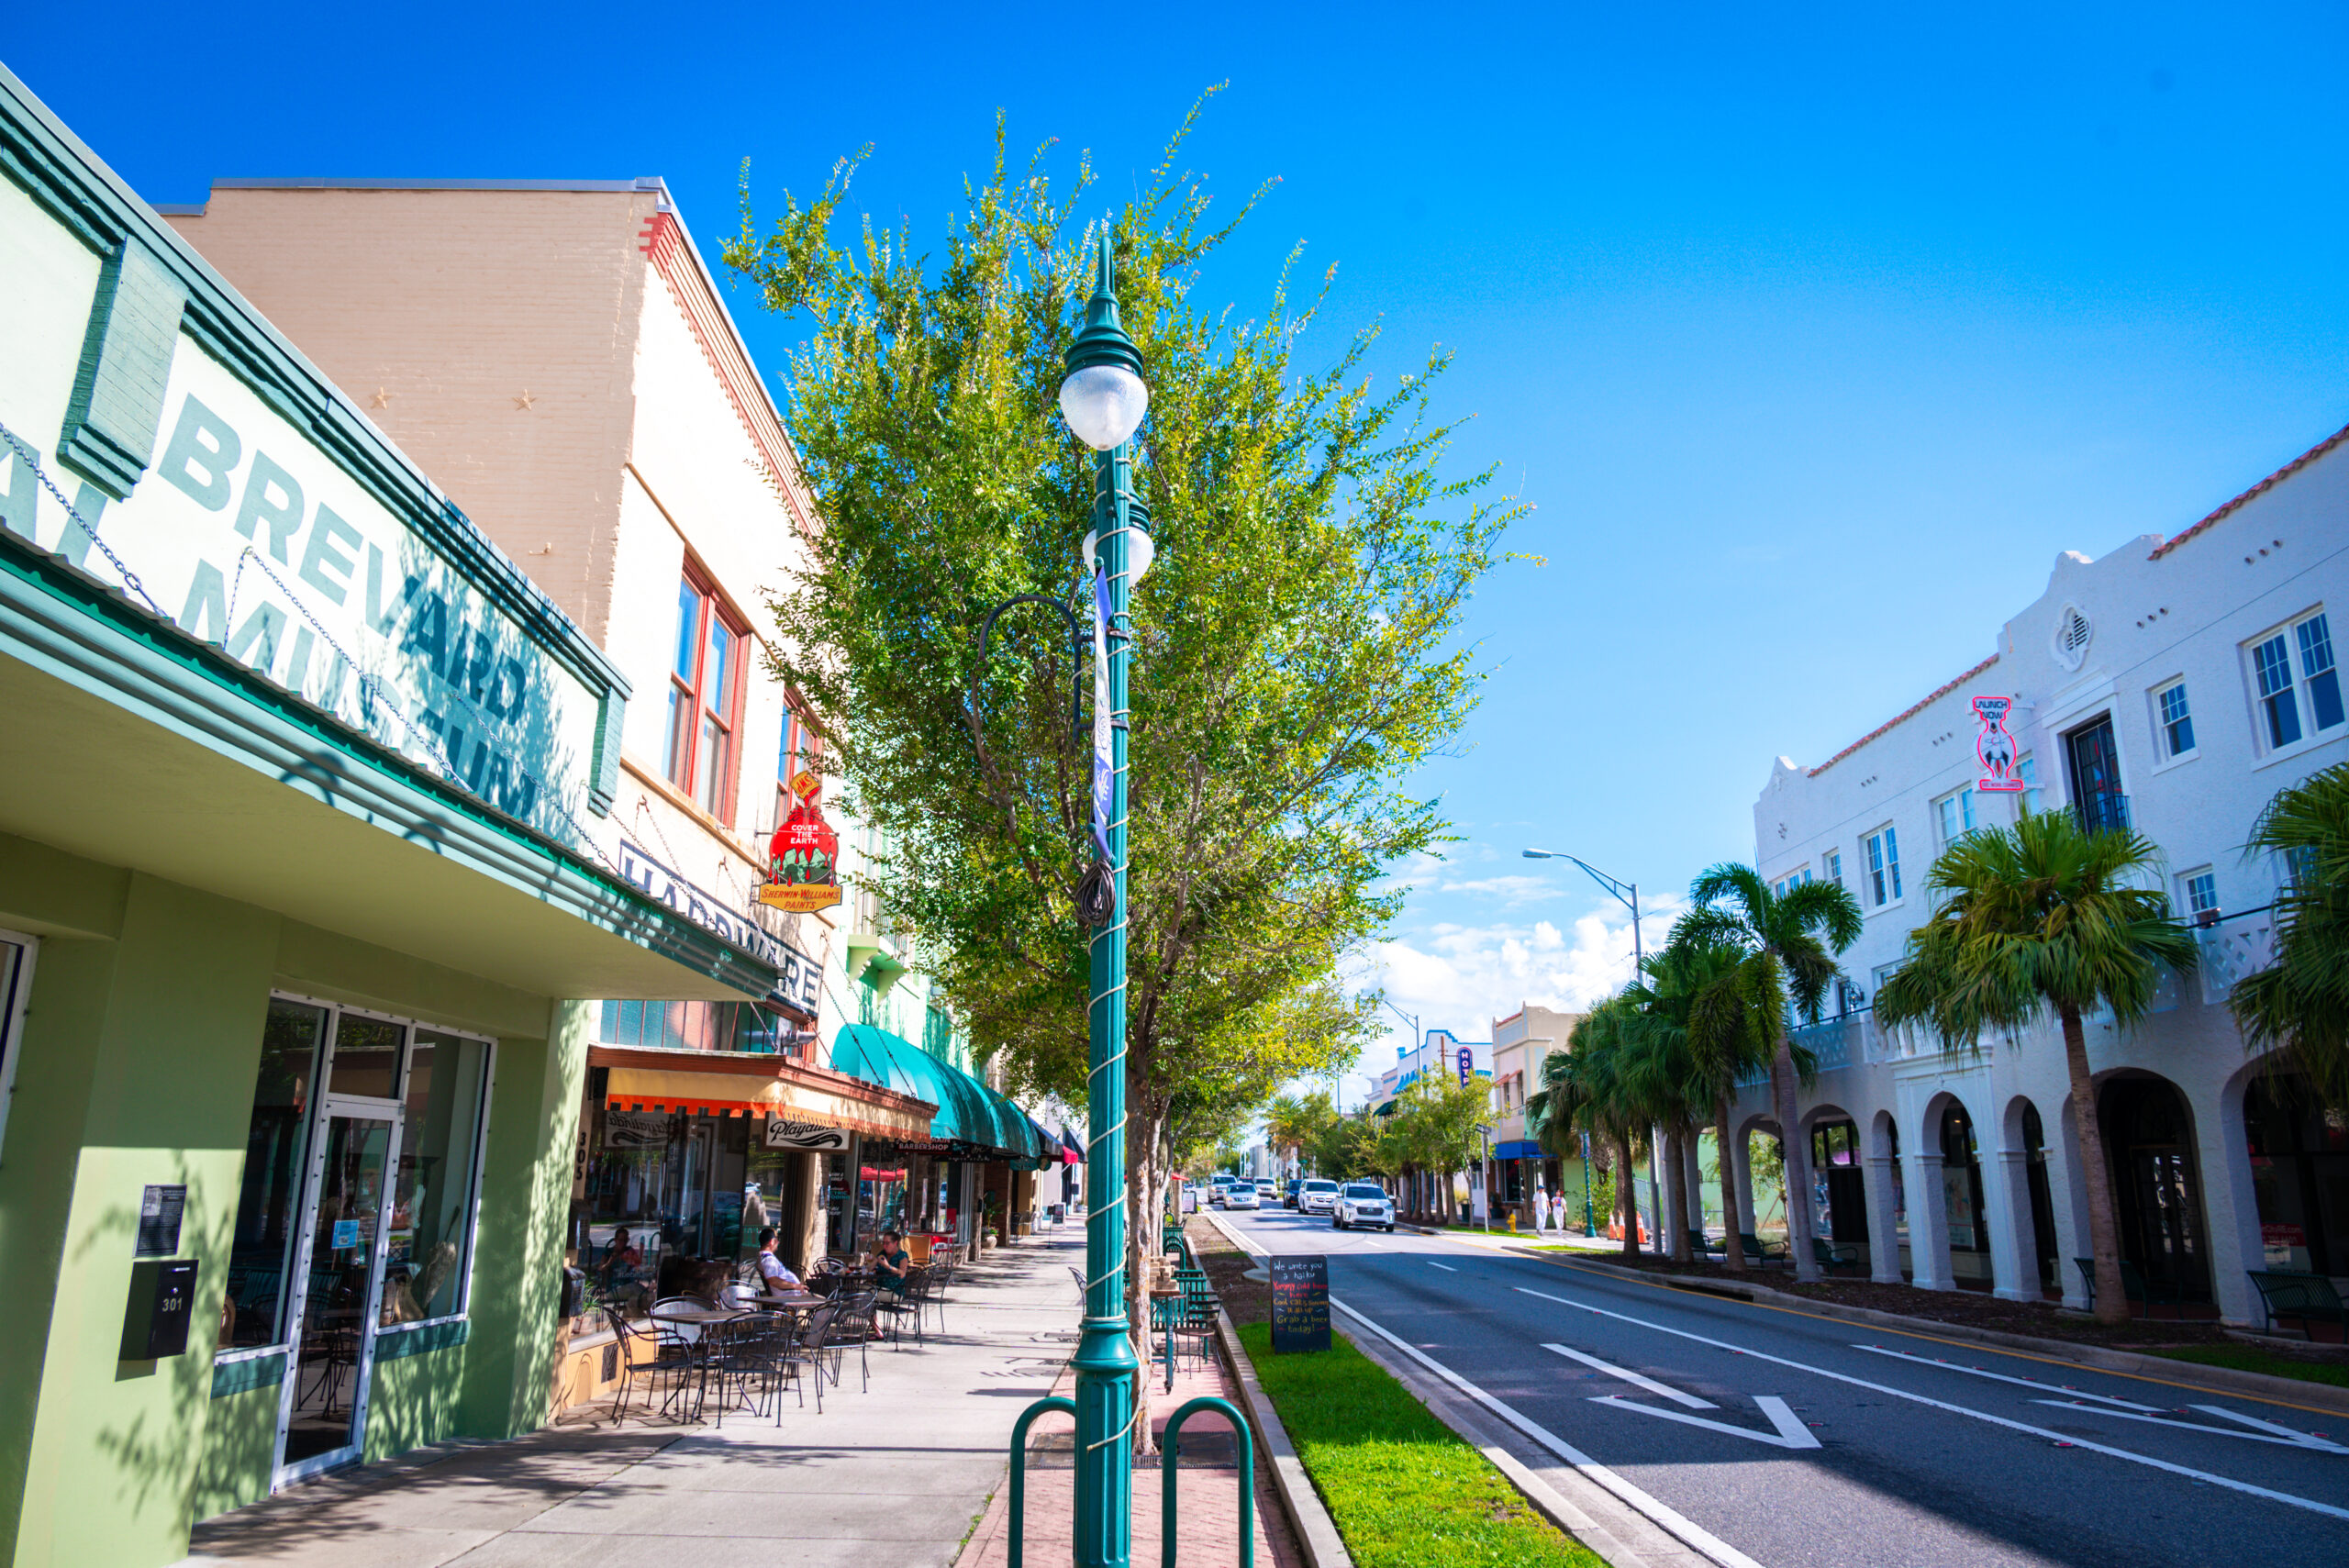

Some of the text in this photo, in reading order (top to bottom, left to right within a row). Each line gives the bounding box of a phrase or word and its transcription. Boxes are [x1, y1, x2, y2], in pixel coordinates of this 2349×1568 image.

[157, 392, 527, 726] BREVARD
[176, 558, 538, 818] MUSEUM
[1975, 701, 2008, 709] LAUNCH
[1982, 711, 2003, 719] NOW
[796, 773, 814, 794] SWP
[762, 887, 840, 899] SHERWIN-WILLIAMS
[784, 901, 817, 909] PAINTS
[575, 1131, 587, 1182] 305
[1274, 1260, 1285, 1271] We
[1310, 1262, 1323, 1271] you
[1294, 1271, 1315, 1280] haiku
[161, 1296, 183, 1312] 301
[1276, 1315, 1299, 1324] Grab
[1287, 1323, 1315, 1334] today!
